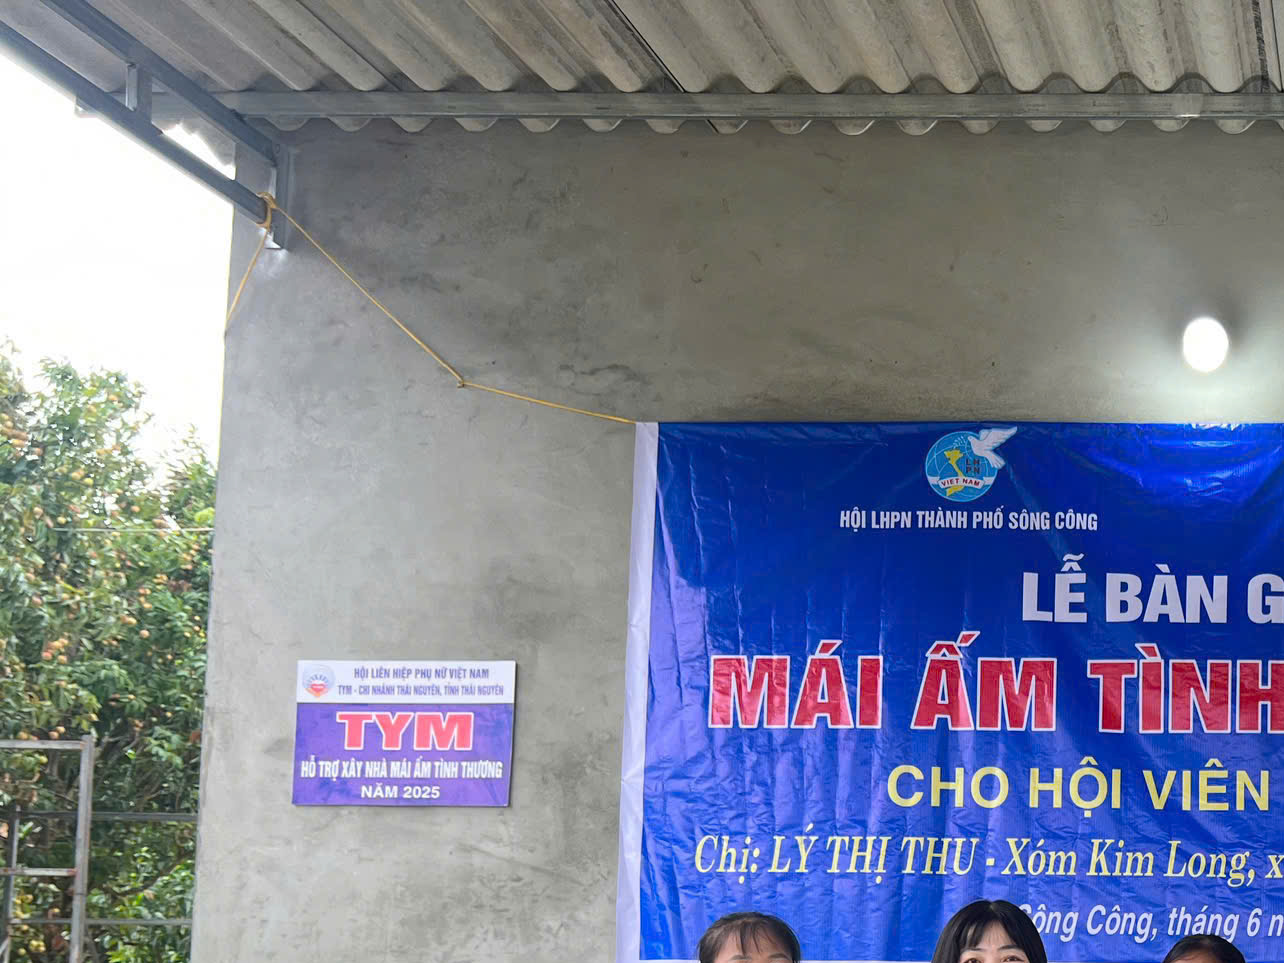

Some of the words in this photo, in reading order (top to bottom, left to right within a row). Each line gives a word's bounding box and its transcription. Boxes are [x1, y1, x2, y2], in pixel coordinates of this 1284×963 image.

[962, 478, 980, 487] NAM
[840, 507, 866, 532] HỘI
[871, 511, 912, 529] LHPN
[916, 507, 968, 529] THÀNH
[972, 506, 1004, 529] PHỐ
[1008, 509, 1050, 530] SÔNG
[1055, 508, 1098, 531] CÔNG
[1021, 553, 1088, 623] LỄ
[1105, 564, 1228, 624] BÀN
[337, 685, 352, 695] TYM
[359, 685, 370, 695] CHI
[372, 682, 395, 695] NHÁNH
[397, 683, 411, 695] THÁI
[461, 683, 476, 695] THÁI
[477, 684, 504, 696] NGUYÊN
[354, 666, 369, 681] HỘI
[371, 666, 390, 679] LIÊN
[393, 666, 412, 681] HIỆP
[415, 668, 432, 681] PHỤ
[435, 666, 448, 679] NỮ
[449, 666, 467, 681] VIỆT
[470, 668, 489, 679] NAM
[708, 639, 884, 729] MÁI
[910, 630, 1058, 732] ẤM
[336, 711, 474, 751] TYM
[300, 755, 316, 778] HỖ
[319, 759, 340, 781] TRỢ
[341, 757, 363, 778] XÂY
[365, 757, 388, 778] NHÀ
[390, 757, 411, 778] MÁI
[413, 755, 432, 778] ẤM
[434, 757, 459, 778] TÌNH
[461, 760, 503, 778] THƯƠNG
[361, 782, 399, 798] NĂM
[402, 786, 441, 798] 2025
[887, 765, 1010, 809] CHO
[1029, 756, 1121, 818] HỘI
[1142, 758, 1269, 811] VIÊN
[694, 835, 760, 885] Chị:
[767, 824, 815, 874] LÝ
[826, 837, 889, 885] THỊ
[900, 837, 980, 875] THU
[1001, 836, 1078, 877] Xóm
[1086, 838, 1154, 878] Kim
[1166, 840, 1256, 887] Long,
[1086, 904, 1158, 944] Công,
[1167, 905, 1240, 944] tháng
[1246, 908, 1263, 937] 6
